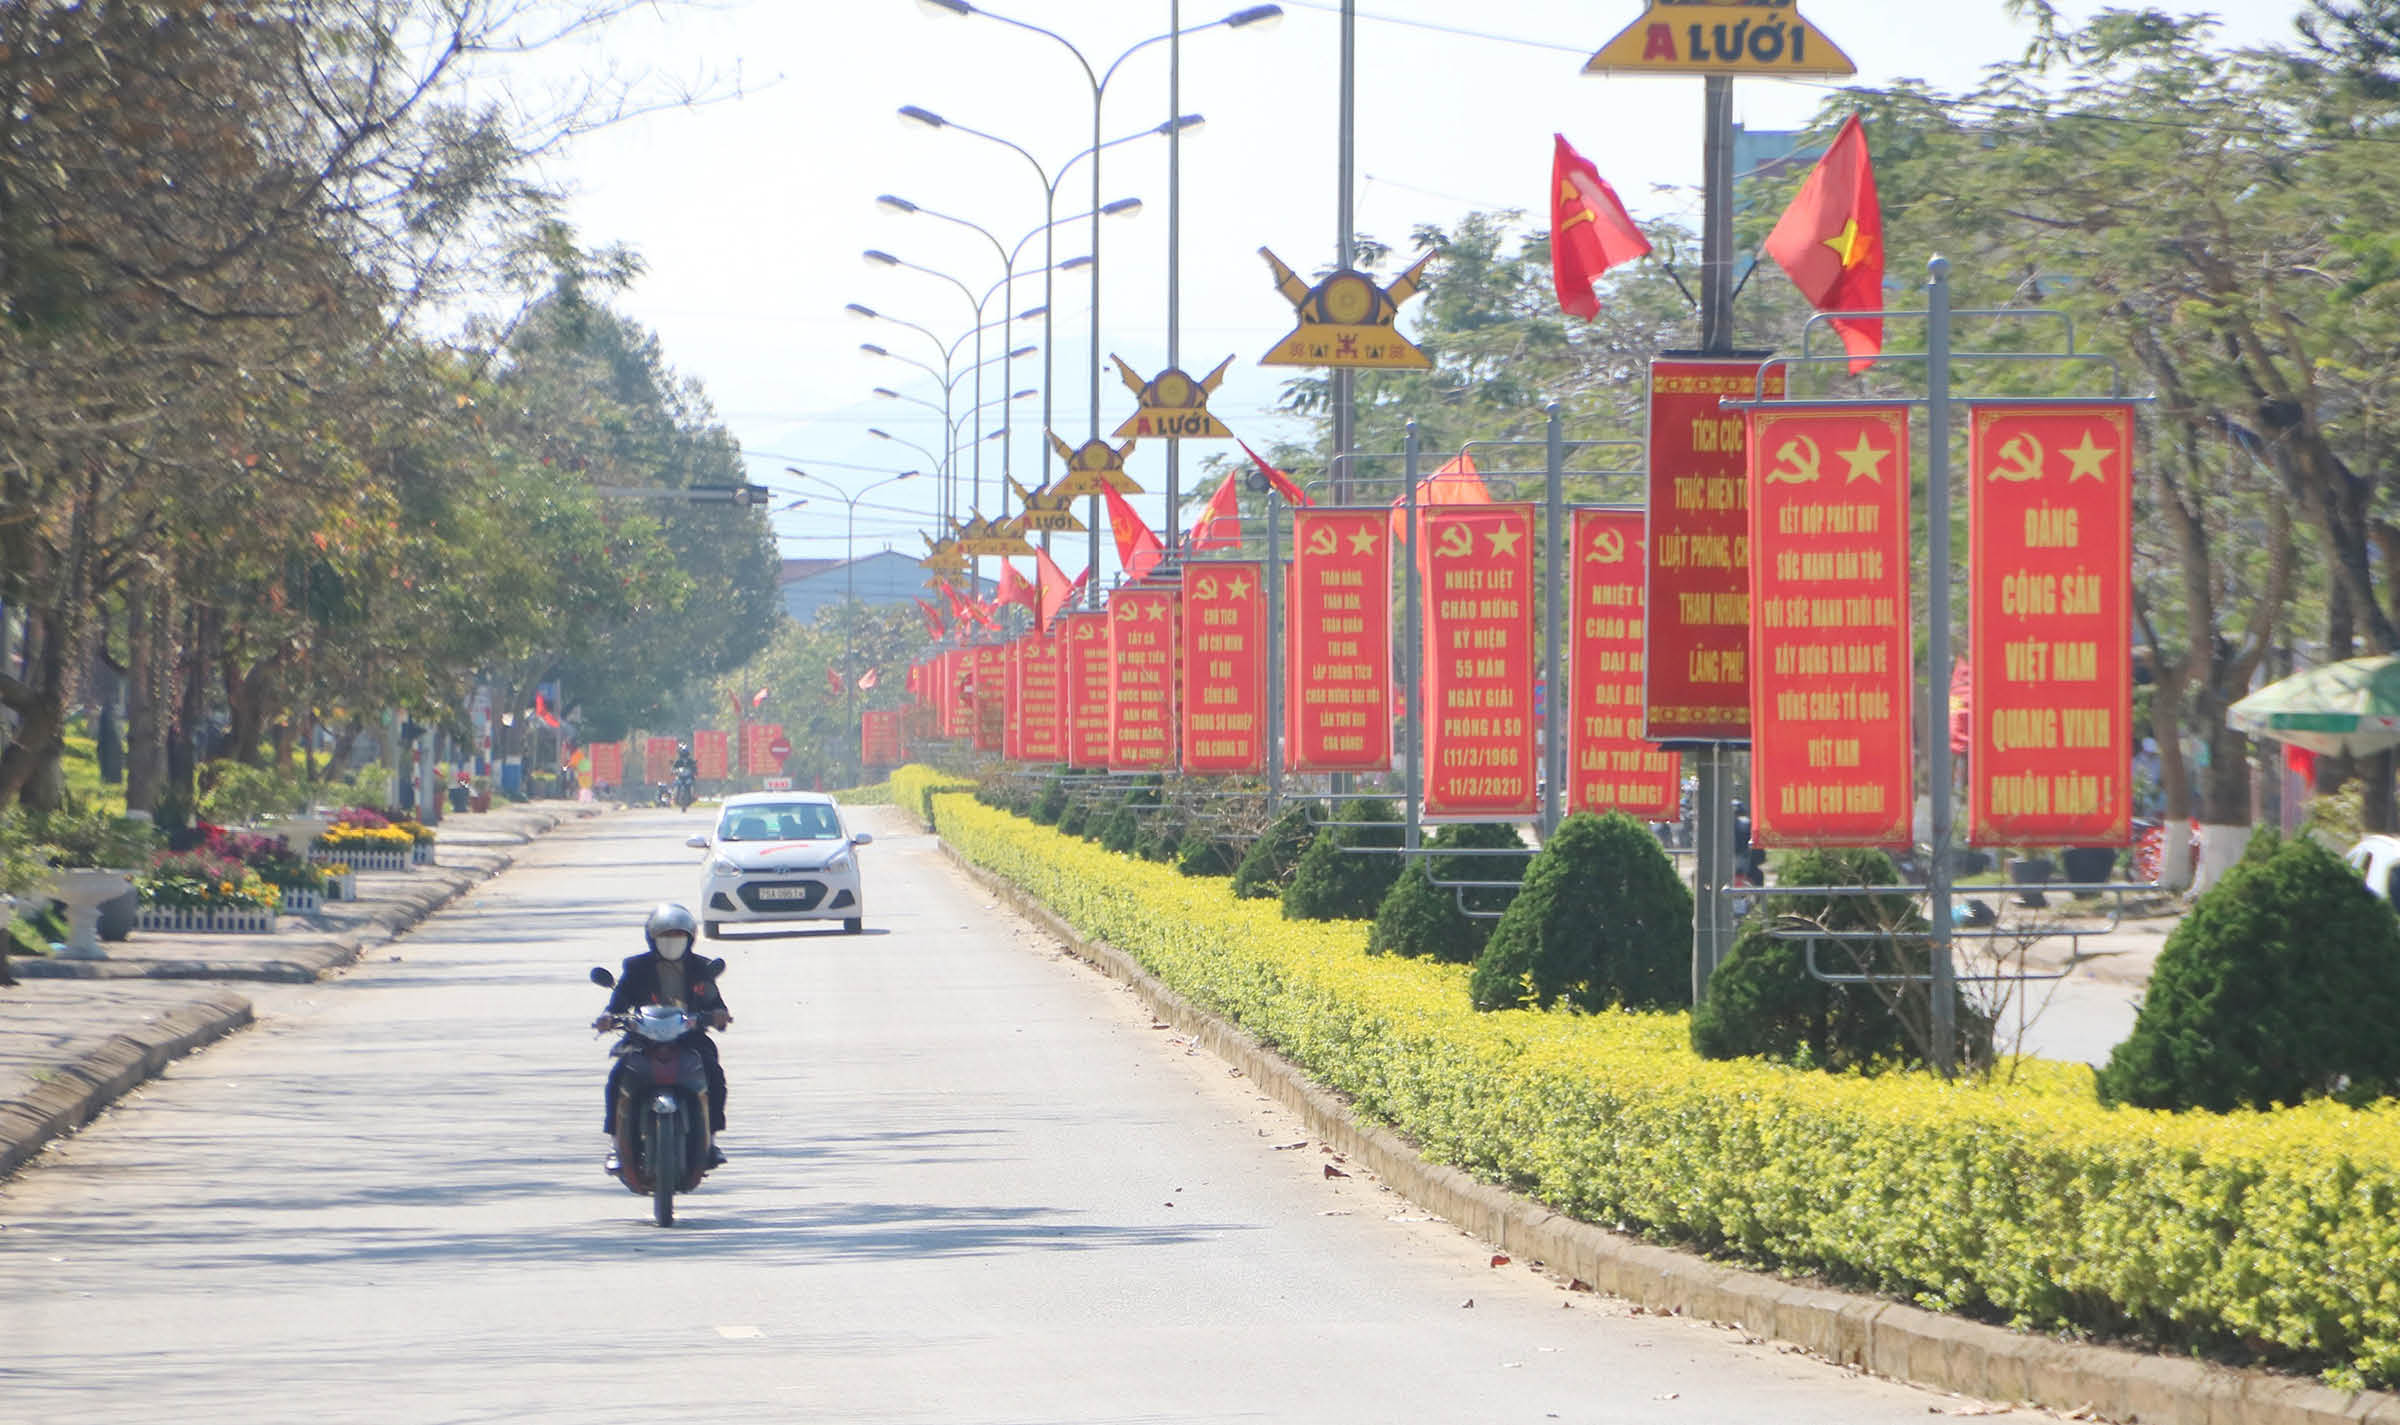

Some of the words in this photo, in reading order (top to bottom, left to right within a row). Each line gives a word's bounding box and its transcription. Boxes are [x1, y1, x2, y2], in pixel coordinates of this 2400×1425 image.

[1642, 23, 1678, 61] A
[1688, 13, 1804, 63] LƯỚI
[1137, 418, 1151, 435] A
[1692, 413, 1718, 452] TÍCH
[1721, 415, 1744, 457] CỰC
[1674, 472, 1705, 515] THỰC
[1707, 469, 1734, 515] HIỆN
[2025, 498, 2079, 548] ĐẢNG
[1659, 527, 1688, 573] LUẬT
[1445, 568, 1483, 592] NHIỆT
[1487, 568, 1514, 592] LIỆT
[1592, 582, 1634, 607] NHIỆT
[2002, 568, 2056, 623] CỘNG
[2061, 565, 2101, 615] SẢN
[1441, 597, 1477, 619] CHÀO
[1481, 597, 1519, 619] MỪNG
[1679, 592, 1711, 625] THAM
[1474, 626, 1507, 652] NIỆM
[1585, 616, 1625, 639] CHÀO
[1456, 659, 1473, 678] 55
[1477, 656, 1505, 678] NĂM
[1689, 642, 1719, 682] LÃNG
[2005, 635, 2048, 688] VIỆT
[2053, 642, 2097, 681] NAM
[1447, 686, 1482, 708] NGÀY
[1486, 684, 1513, 708] GIẢI
[1444, 716, 1489, 737] PHÓNG
[1493, 718, 1502, 737] A
[1585, 716, 1623, 738] TOÀN
[1992, 708, 2057, 752] QUANG
[2062, 708, 2110, 748] VINH
[1443, 747, 1518, 767] (11/3/1966
[1581, 745, 1607, 770] LẦN
[1611, 747, 1641, 772] THỨ
[1643, 751, 1668, 772] XIII
[1449, 776, 1522, 796] 11/3/2021)
[1586, 779, 1614, 804] CỦA
[1992, 769, 2049, 815] MUÔN
[2054, 769, 2098, 815] NĂM
